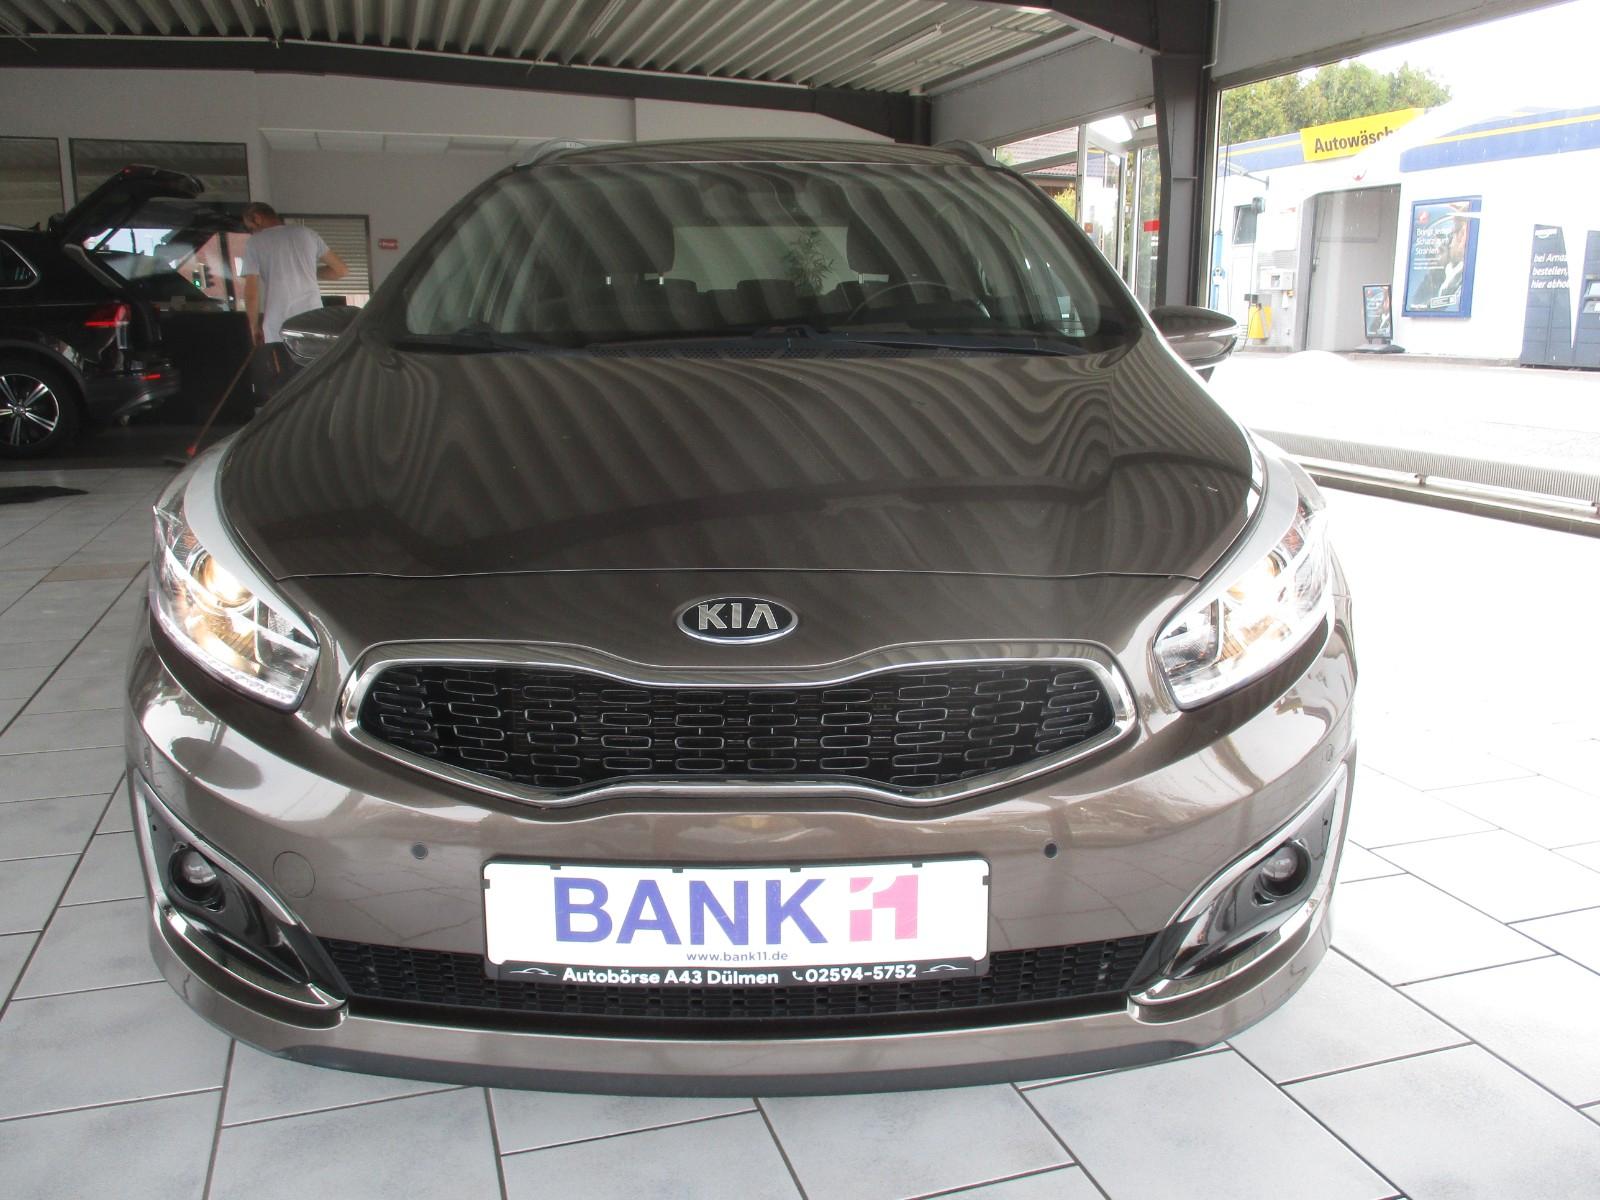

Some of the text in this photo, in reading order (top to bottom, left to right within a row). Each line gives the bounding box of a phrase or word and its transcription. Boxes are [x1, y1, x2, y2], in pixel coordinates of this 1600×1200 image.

[1314, 126, 1397, 154] Autowäsch
[1530, 279, 1546, 289] hier
[697, 602, 779, 631] KIA
[553, 876, 829, 946] BANK
[686, 950, 789, 963] www.bank11.de
[562, 964, 918, 985] Autobörse A43 Dülmen 02594-5752
